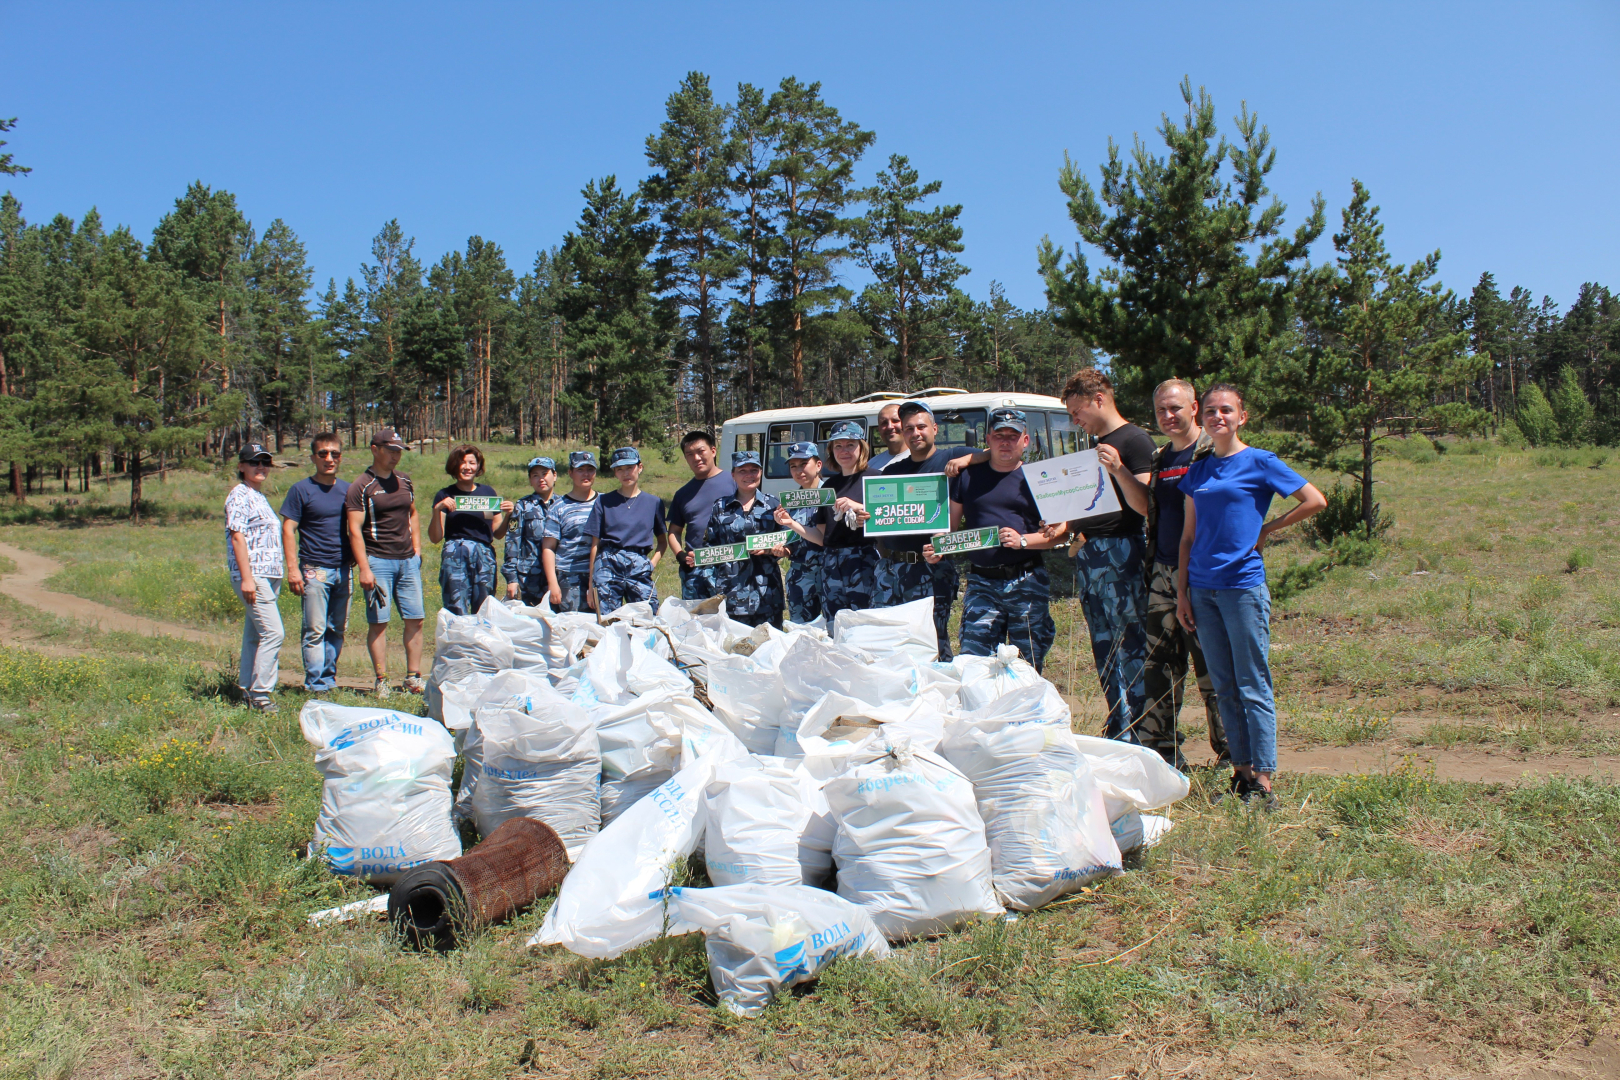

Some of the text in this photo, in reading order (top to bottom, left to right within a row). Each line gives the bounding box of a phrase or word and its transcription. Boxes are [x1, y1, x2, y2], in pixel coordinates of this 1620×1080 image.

[459, 497, 490, 506] #ЗАБЕРИ
[785, 490, 820, 500] #ЗАБЕРИ
[874, 503, 925, 518] #ЗАБЕРИ
[875, 517, 895, 526] МУСОР
[903, 515, 925, 524] СОБОЙ!
[752, 532, 787, 544] #ЗАБЕРИ
[939, 530, 981, 545] #ЗАБЕРИ
[699, 545, 734, 557] #ЗАБЕРИ
[358, 713, 401, 731] ВОДА
[361, 841, 407, 860] ВОДА
[811, 920, 852, 950] ВОДА
